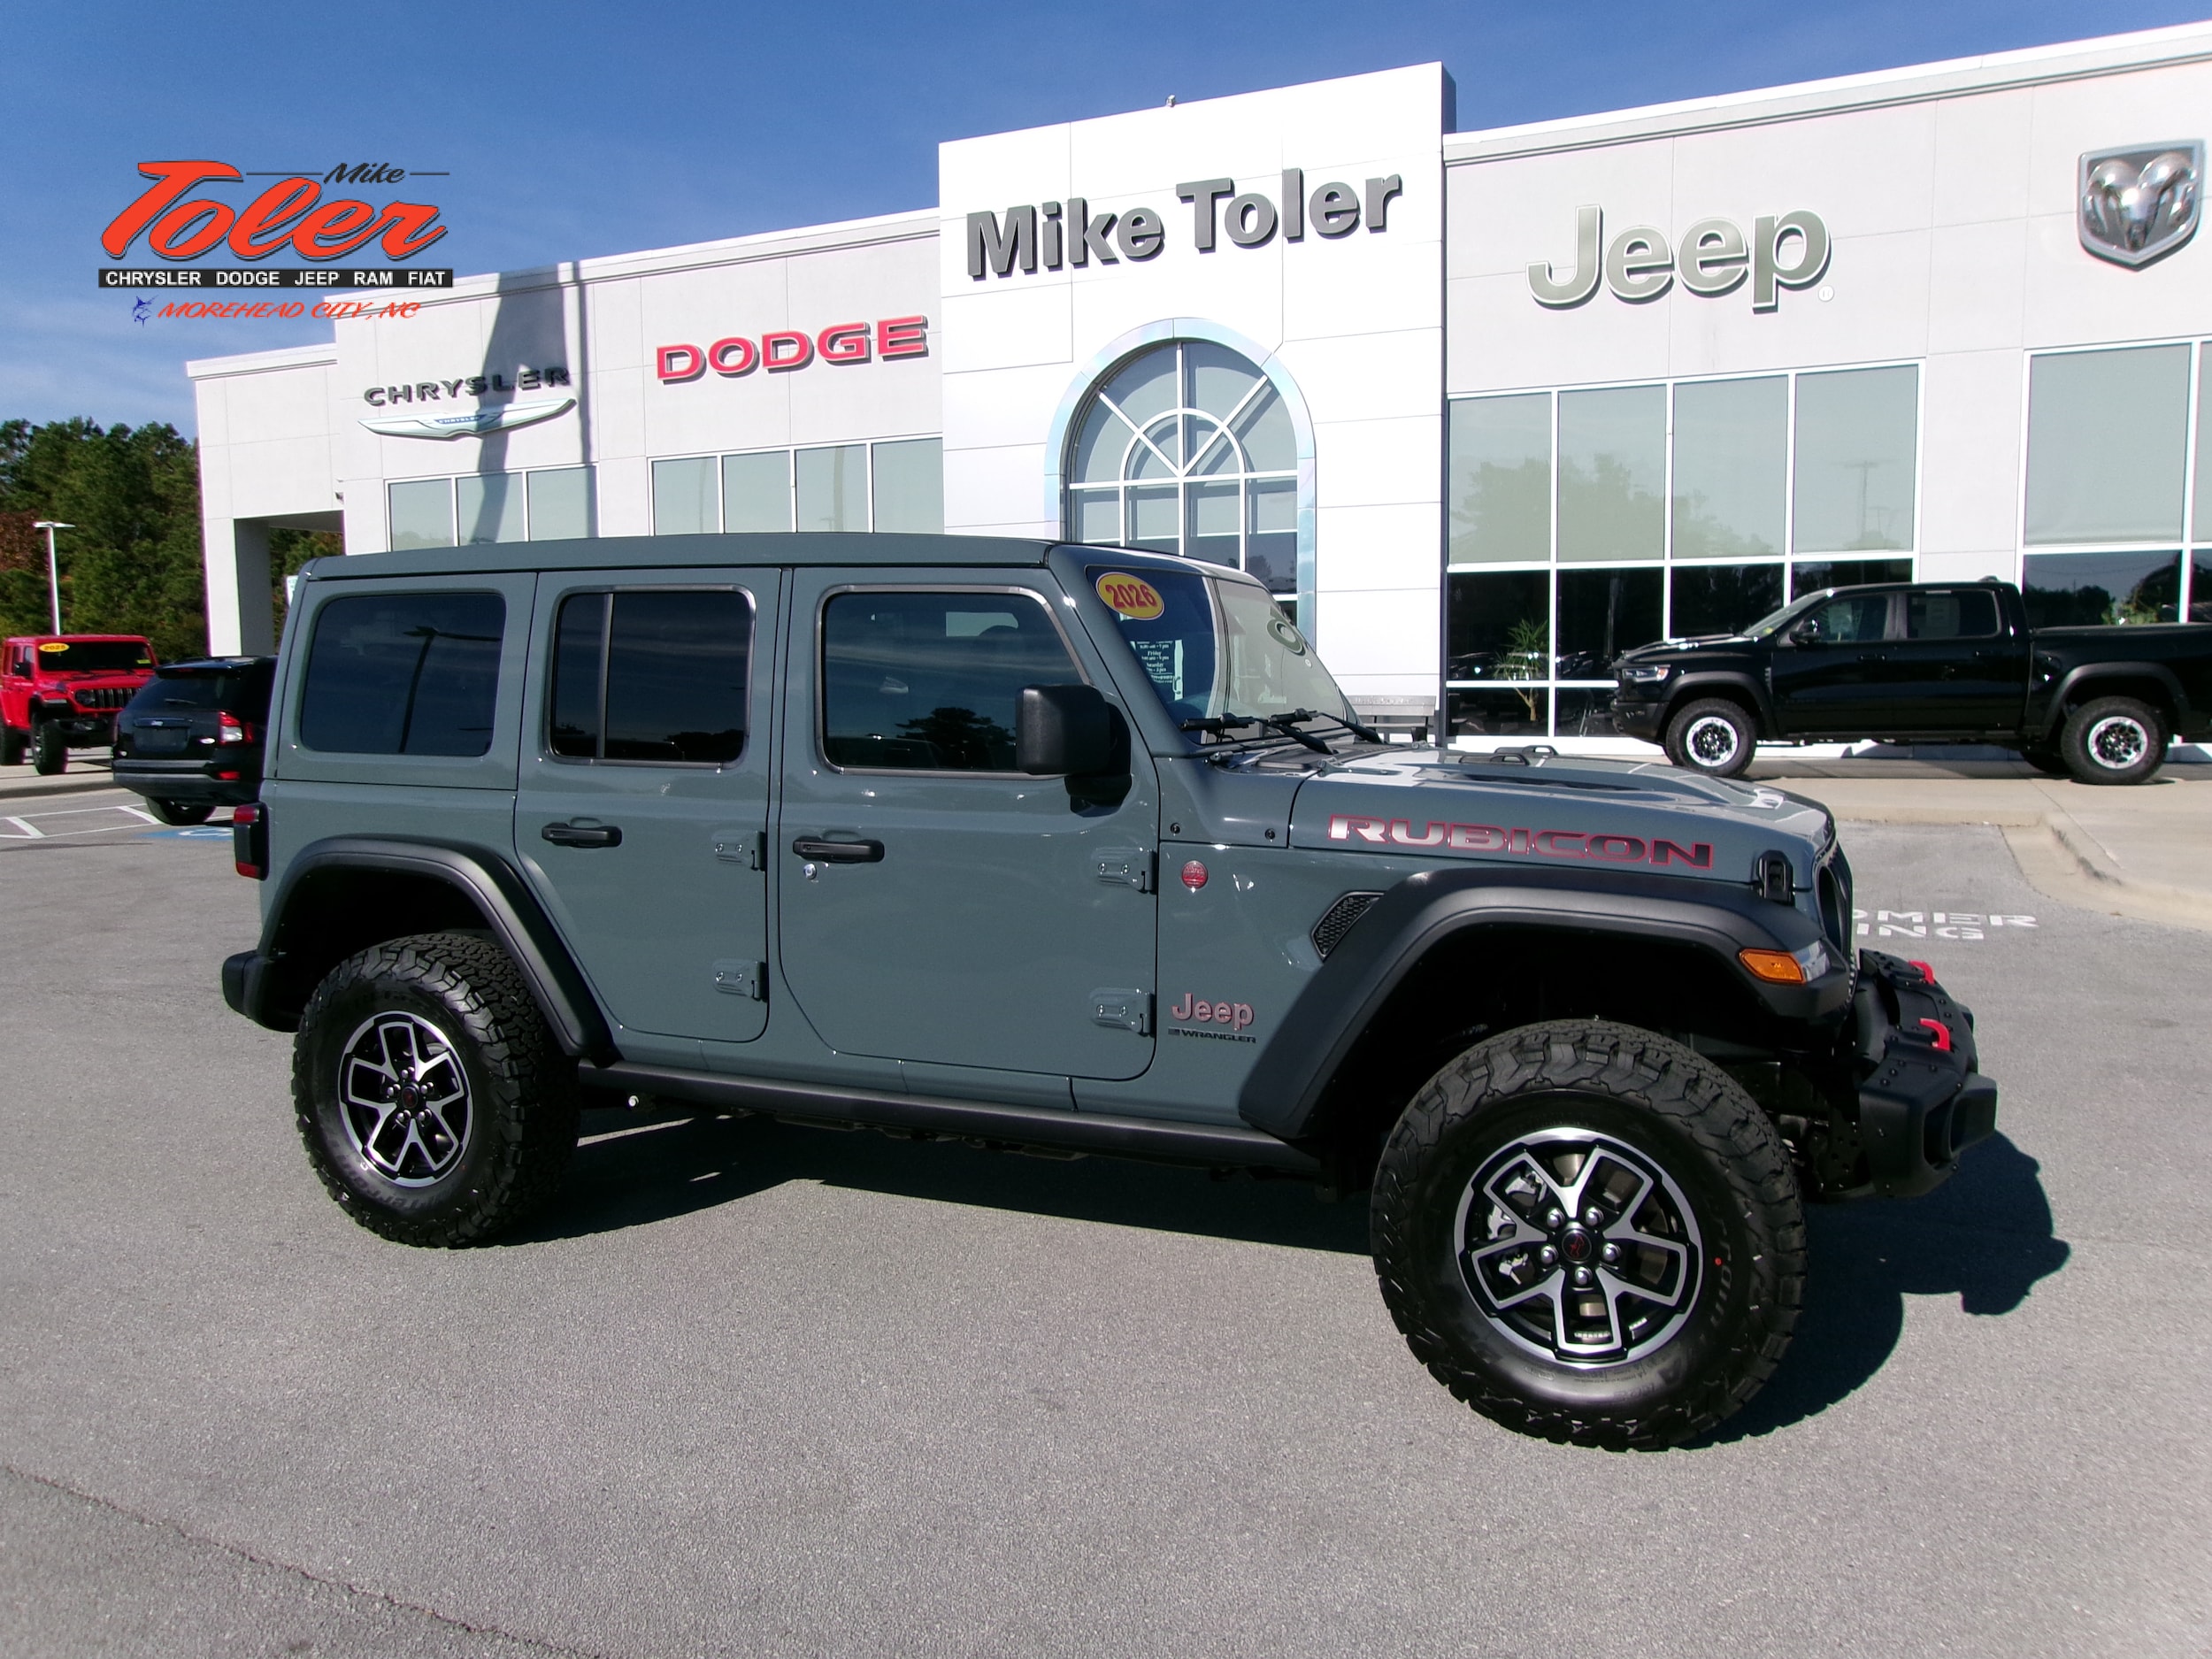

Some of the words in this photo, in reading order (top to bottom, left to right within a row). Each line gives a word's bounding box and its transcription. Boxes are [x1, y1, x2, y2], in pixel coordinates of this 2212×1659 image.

[966, 197, 1164, 280] Mike
[1177, 167, 1402, 252] Toler
[1526, 204, 1832, 313] Jeep
[656, 314, 929, 384] DODGE
[364, 366, 571, 407] CHRYSLER
[1104, 583, 1158, 609] 2026
[1328, 813, 1714, 871] RUBICON
[1171, 993, 1255, 1031] Jeep
[1180, 1028, 1256, 1044] WRANGLER
